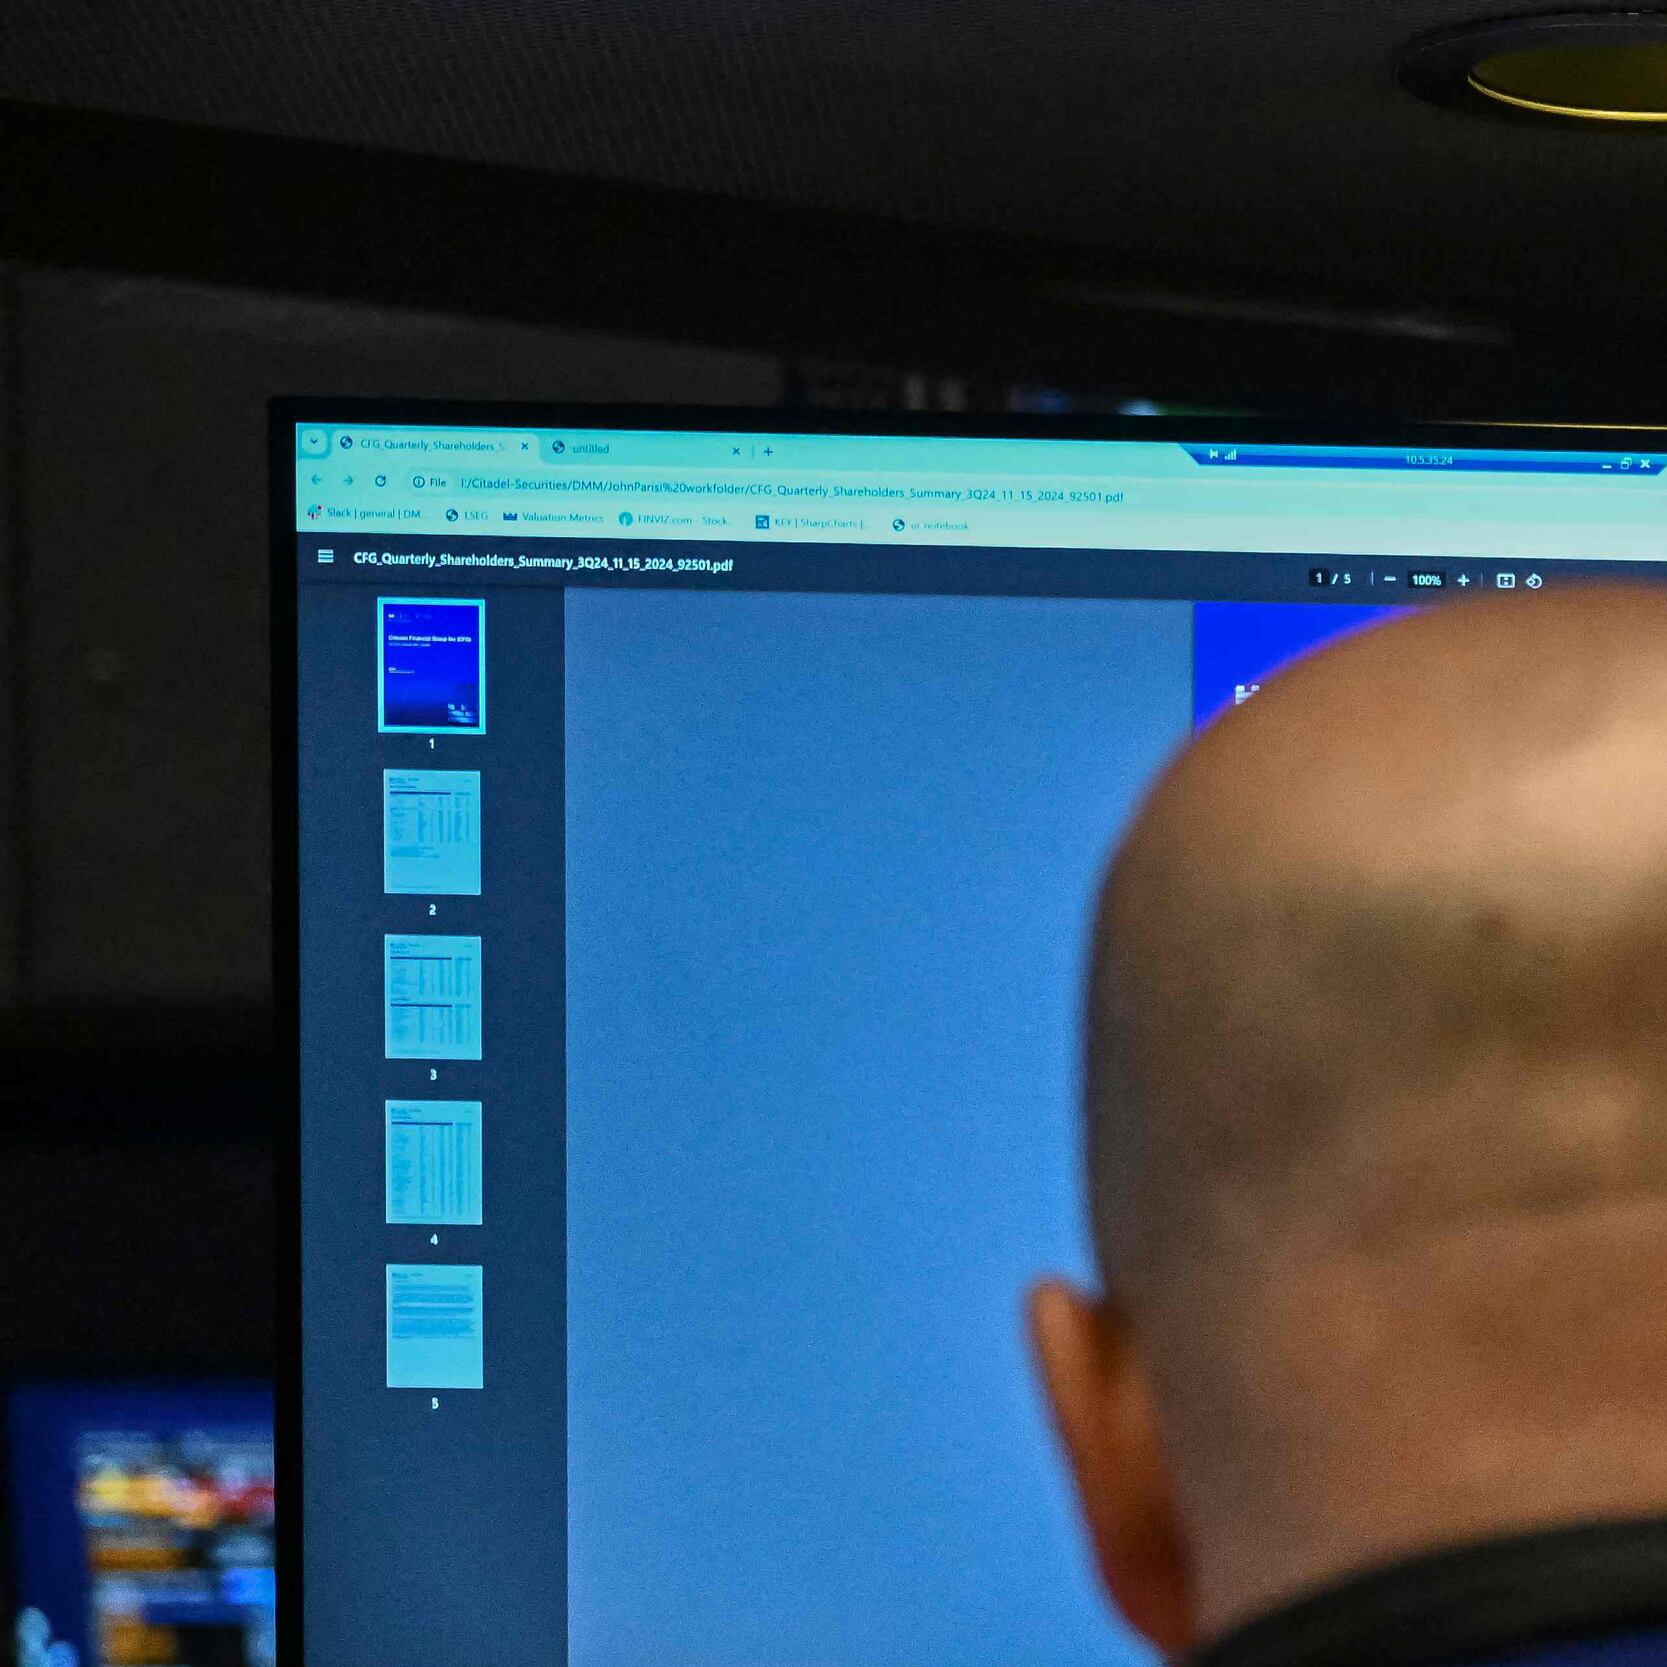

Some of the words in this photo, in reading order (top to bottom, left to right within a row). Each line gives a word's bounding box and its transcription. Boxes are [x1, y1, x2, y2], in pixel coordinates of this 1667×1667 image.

[573, 443, 609, 454] untitled
[1406, 454, 1453, 465] 10.5.35.24
[430, 478, 446, 487] File
[1413, 574, 1441, 586] 100%
